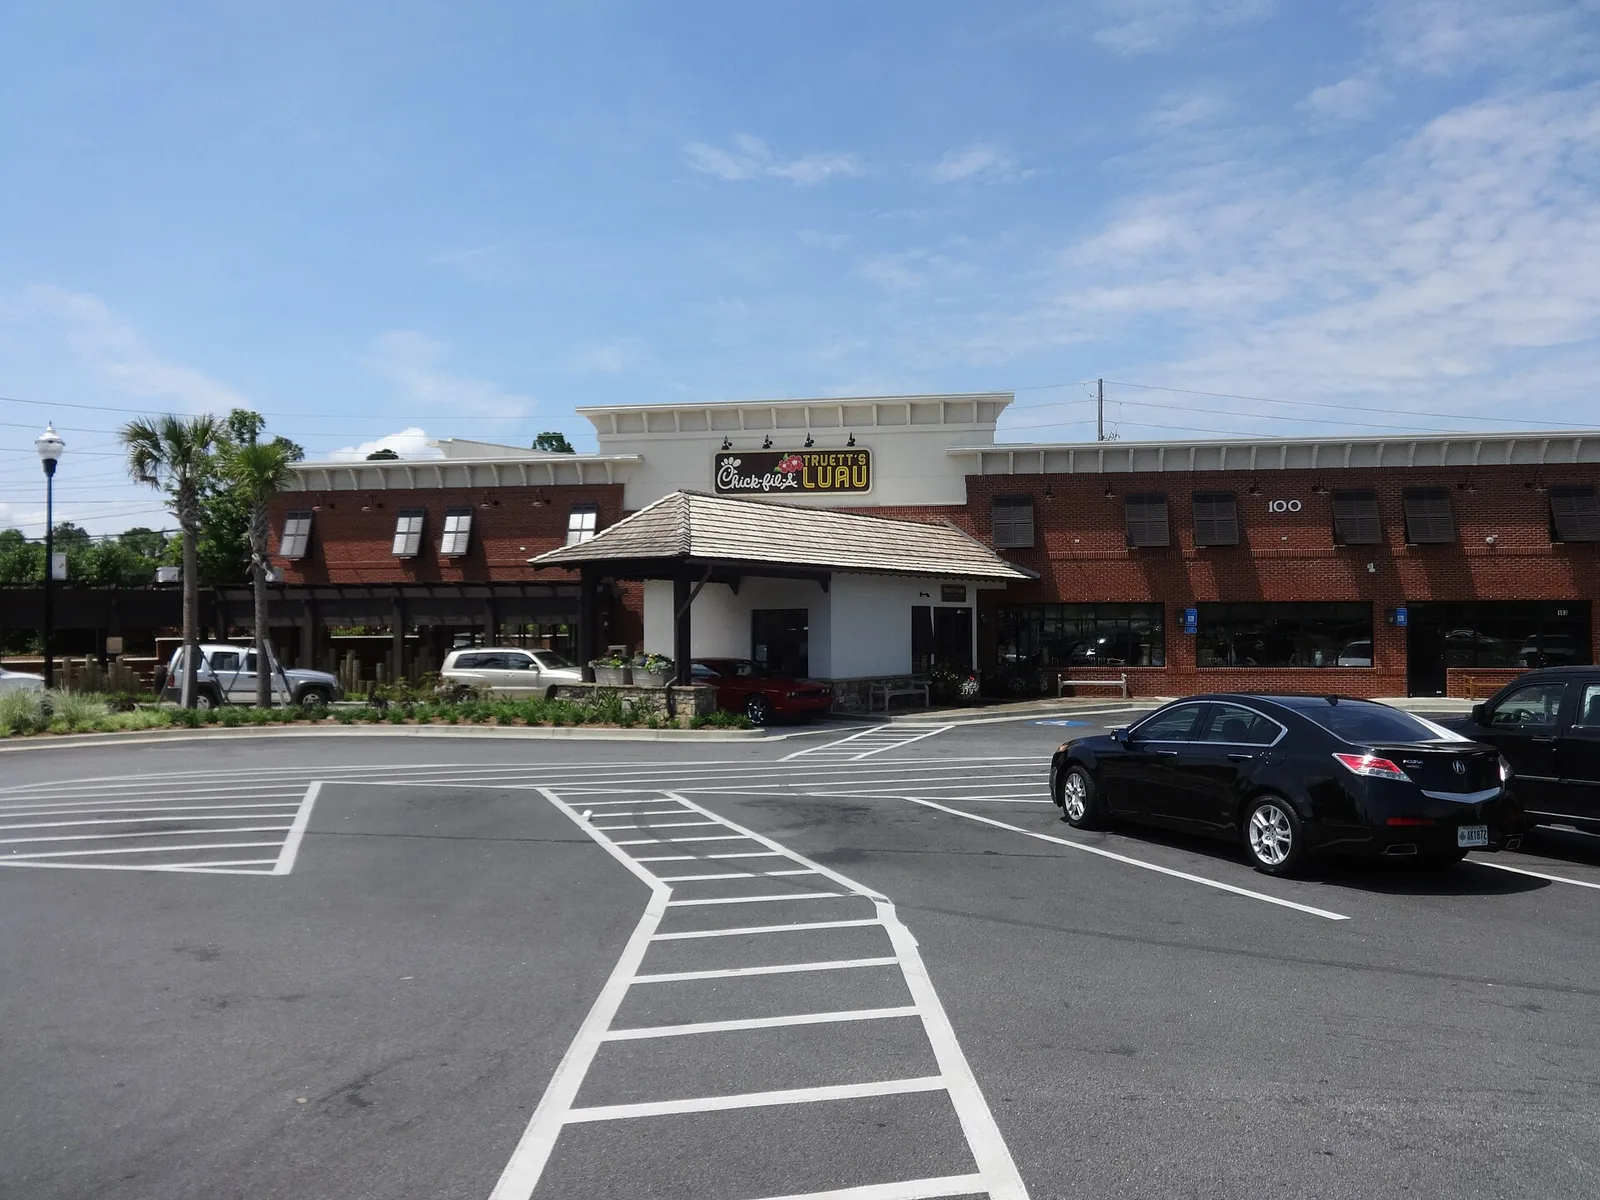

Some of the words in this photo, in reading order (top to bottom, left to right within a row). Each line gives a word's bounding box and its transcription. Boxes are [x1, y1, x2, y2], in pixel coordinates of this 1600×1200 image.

[803, 453, 867, 467] TRUETT'S
[717, 464, 798, 492] Chick-fil-A
[803, 466, 867, 489] LUAU
[1268, 499, 1302, 513] 100
